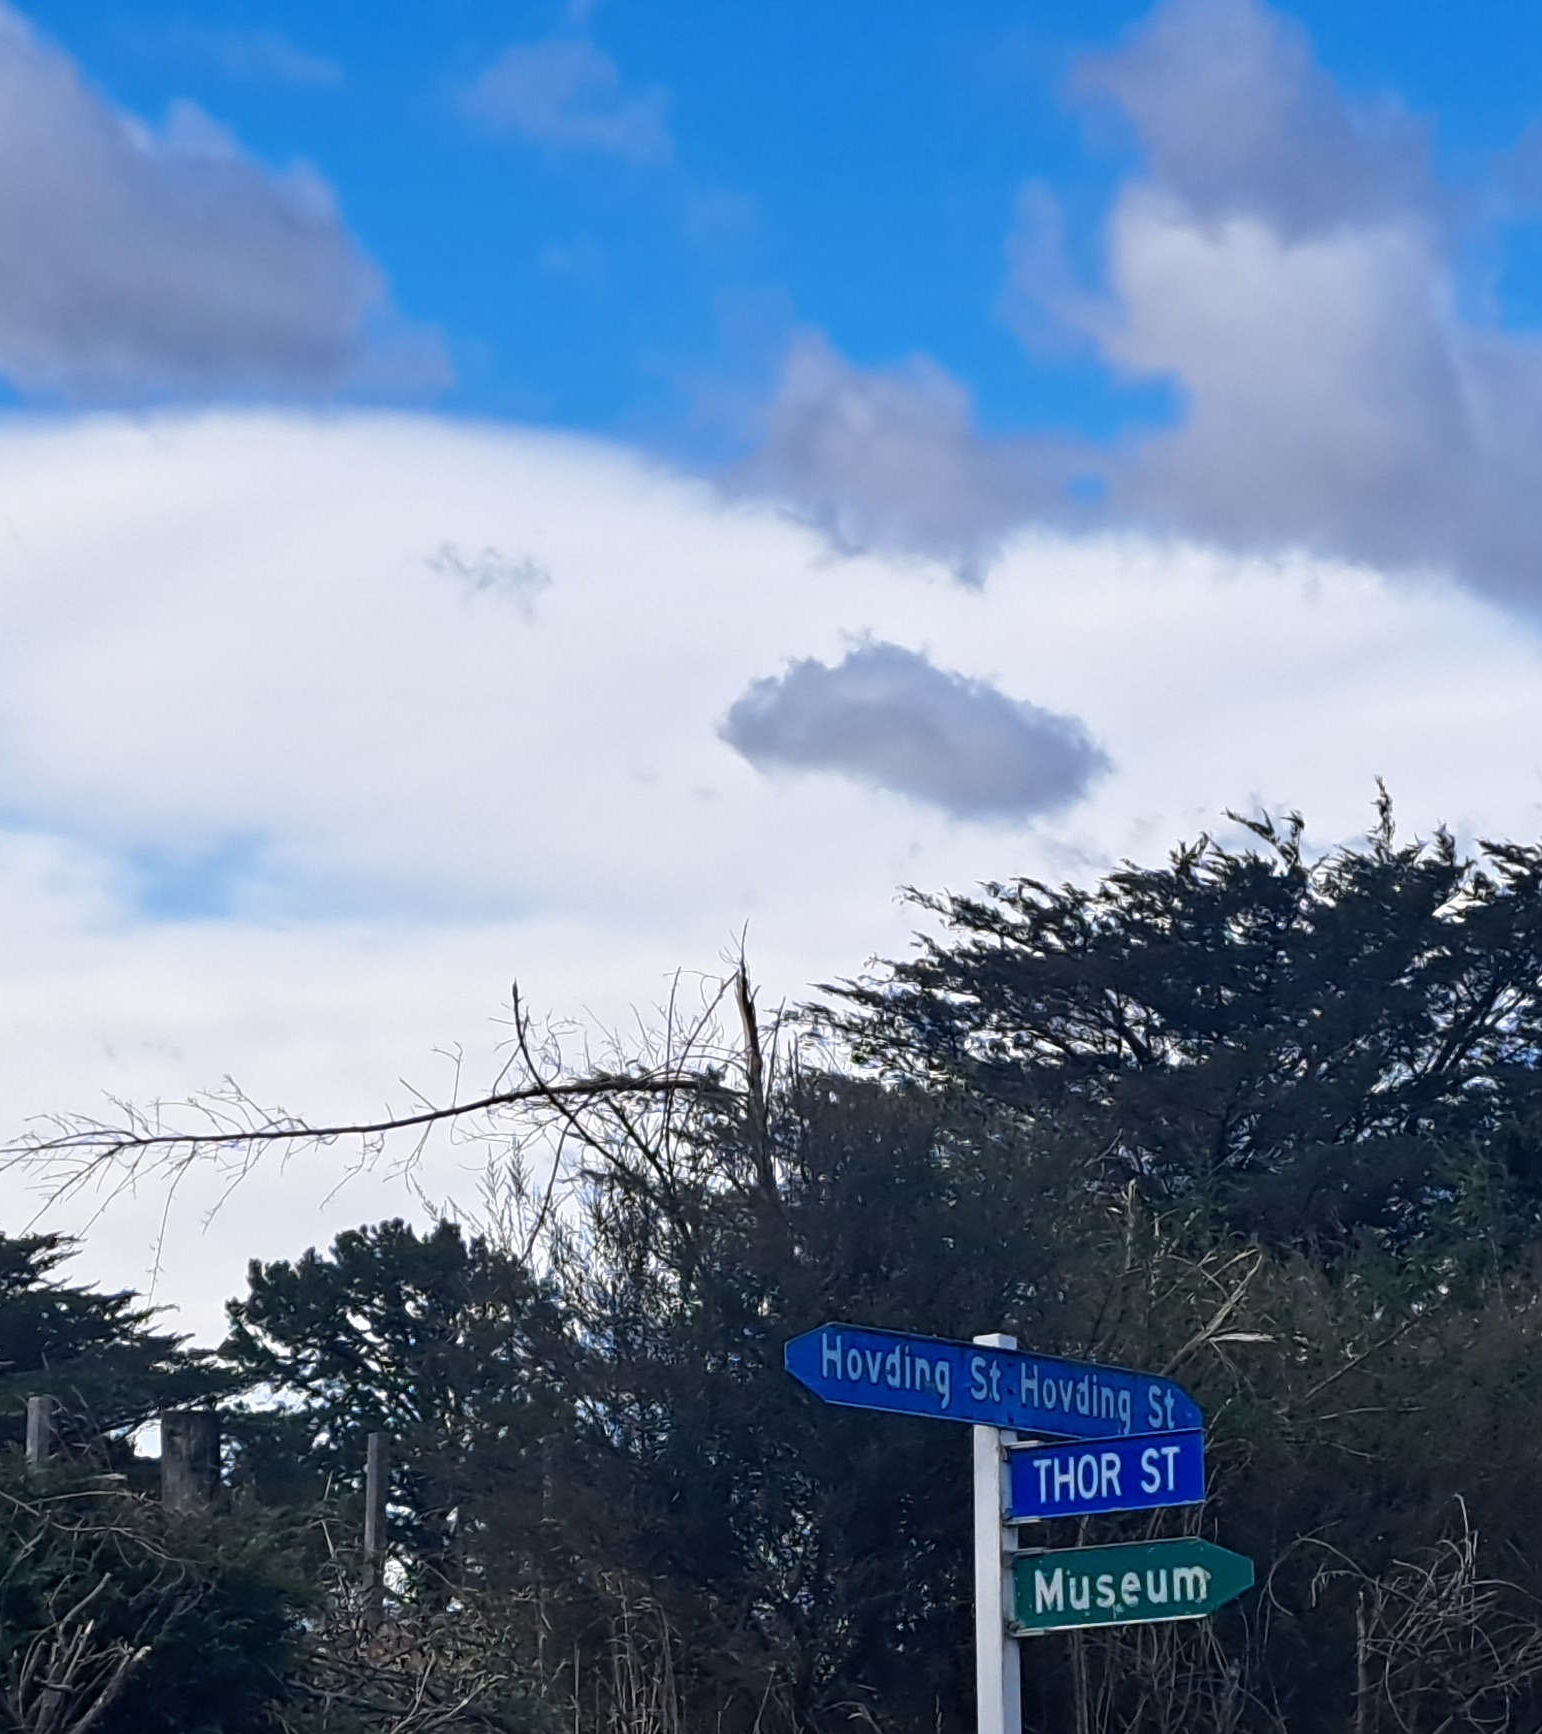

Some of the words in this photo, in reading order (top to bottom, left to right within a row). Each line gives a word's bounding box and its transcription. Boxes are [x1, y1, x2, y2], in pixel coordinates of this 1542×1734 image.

[820, 1331, 953, 1410] Hovding
[970, 1355, 1002, 1403] St
[1020, 1362, 1132, 1436] Hovding
[1147, 1384, 1176, 1430] St
[1033, 1453, 1122, 1504] THOR
[1141, 1446, 1181, 1494] ST
[1034, 1565, 1209, 1614] Museum
